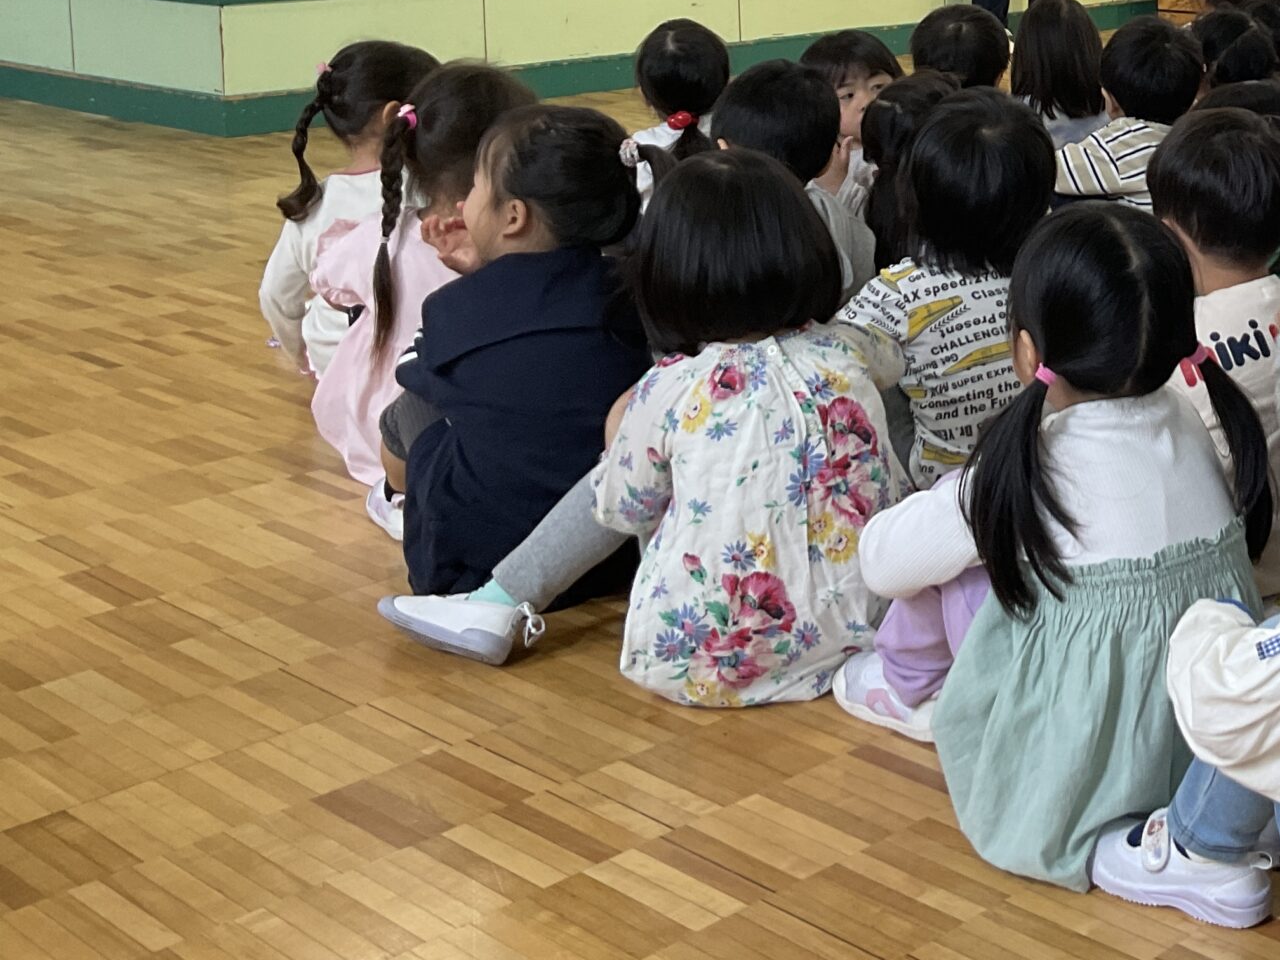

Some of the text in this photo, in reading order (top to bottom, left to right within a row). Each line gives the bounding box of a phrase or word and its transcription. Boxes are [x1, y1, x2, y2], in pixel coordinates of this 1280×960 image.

[997, 380, 1021, 394] the
[935, 407, 959, 421] and
[964, 403, 986, 417] the
